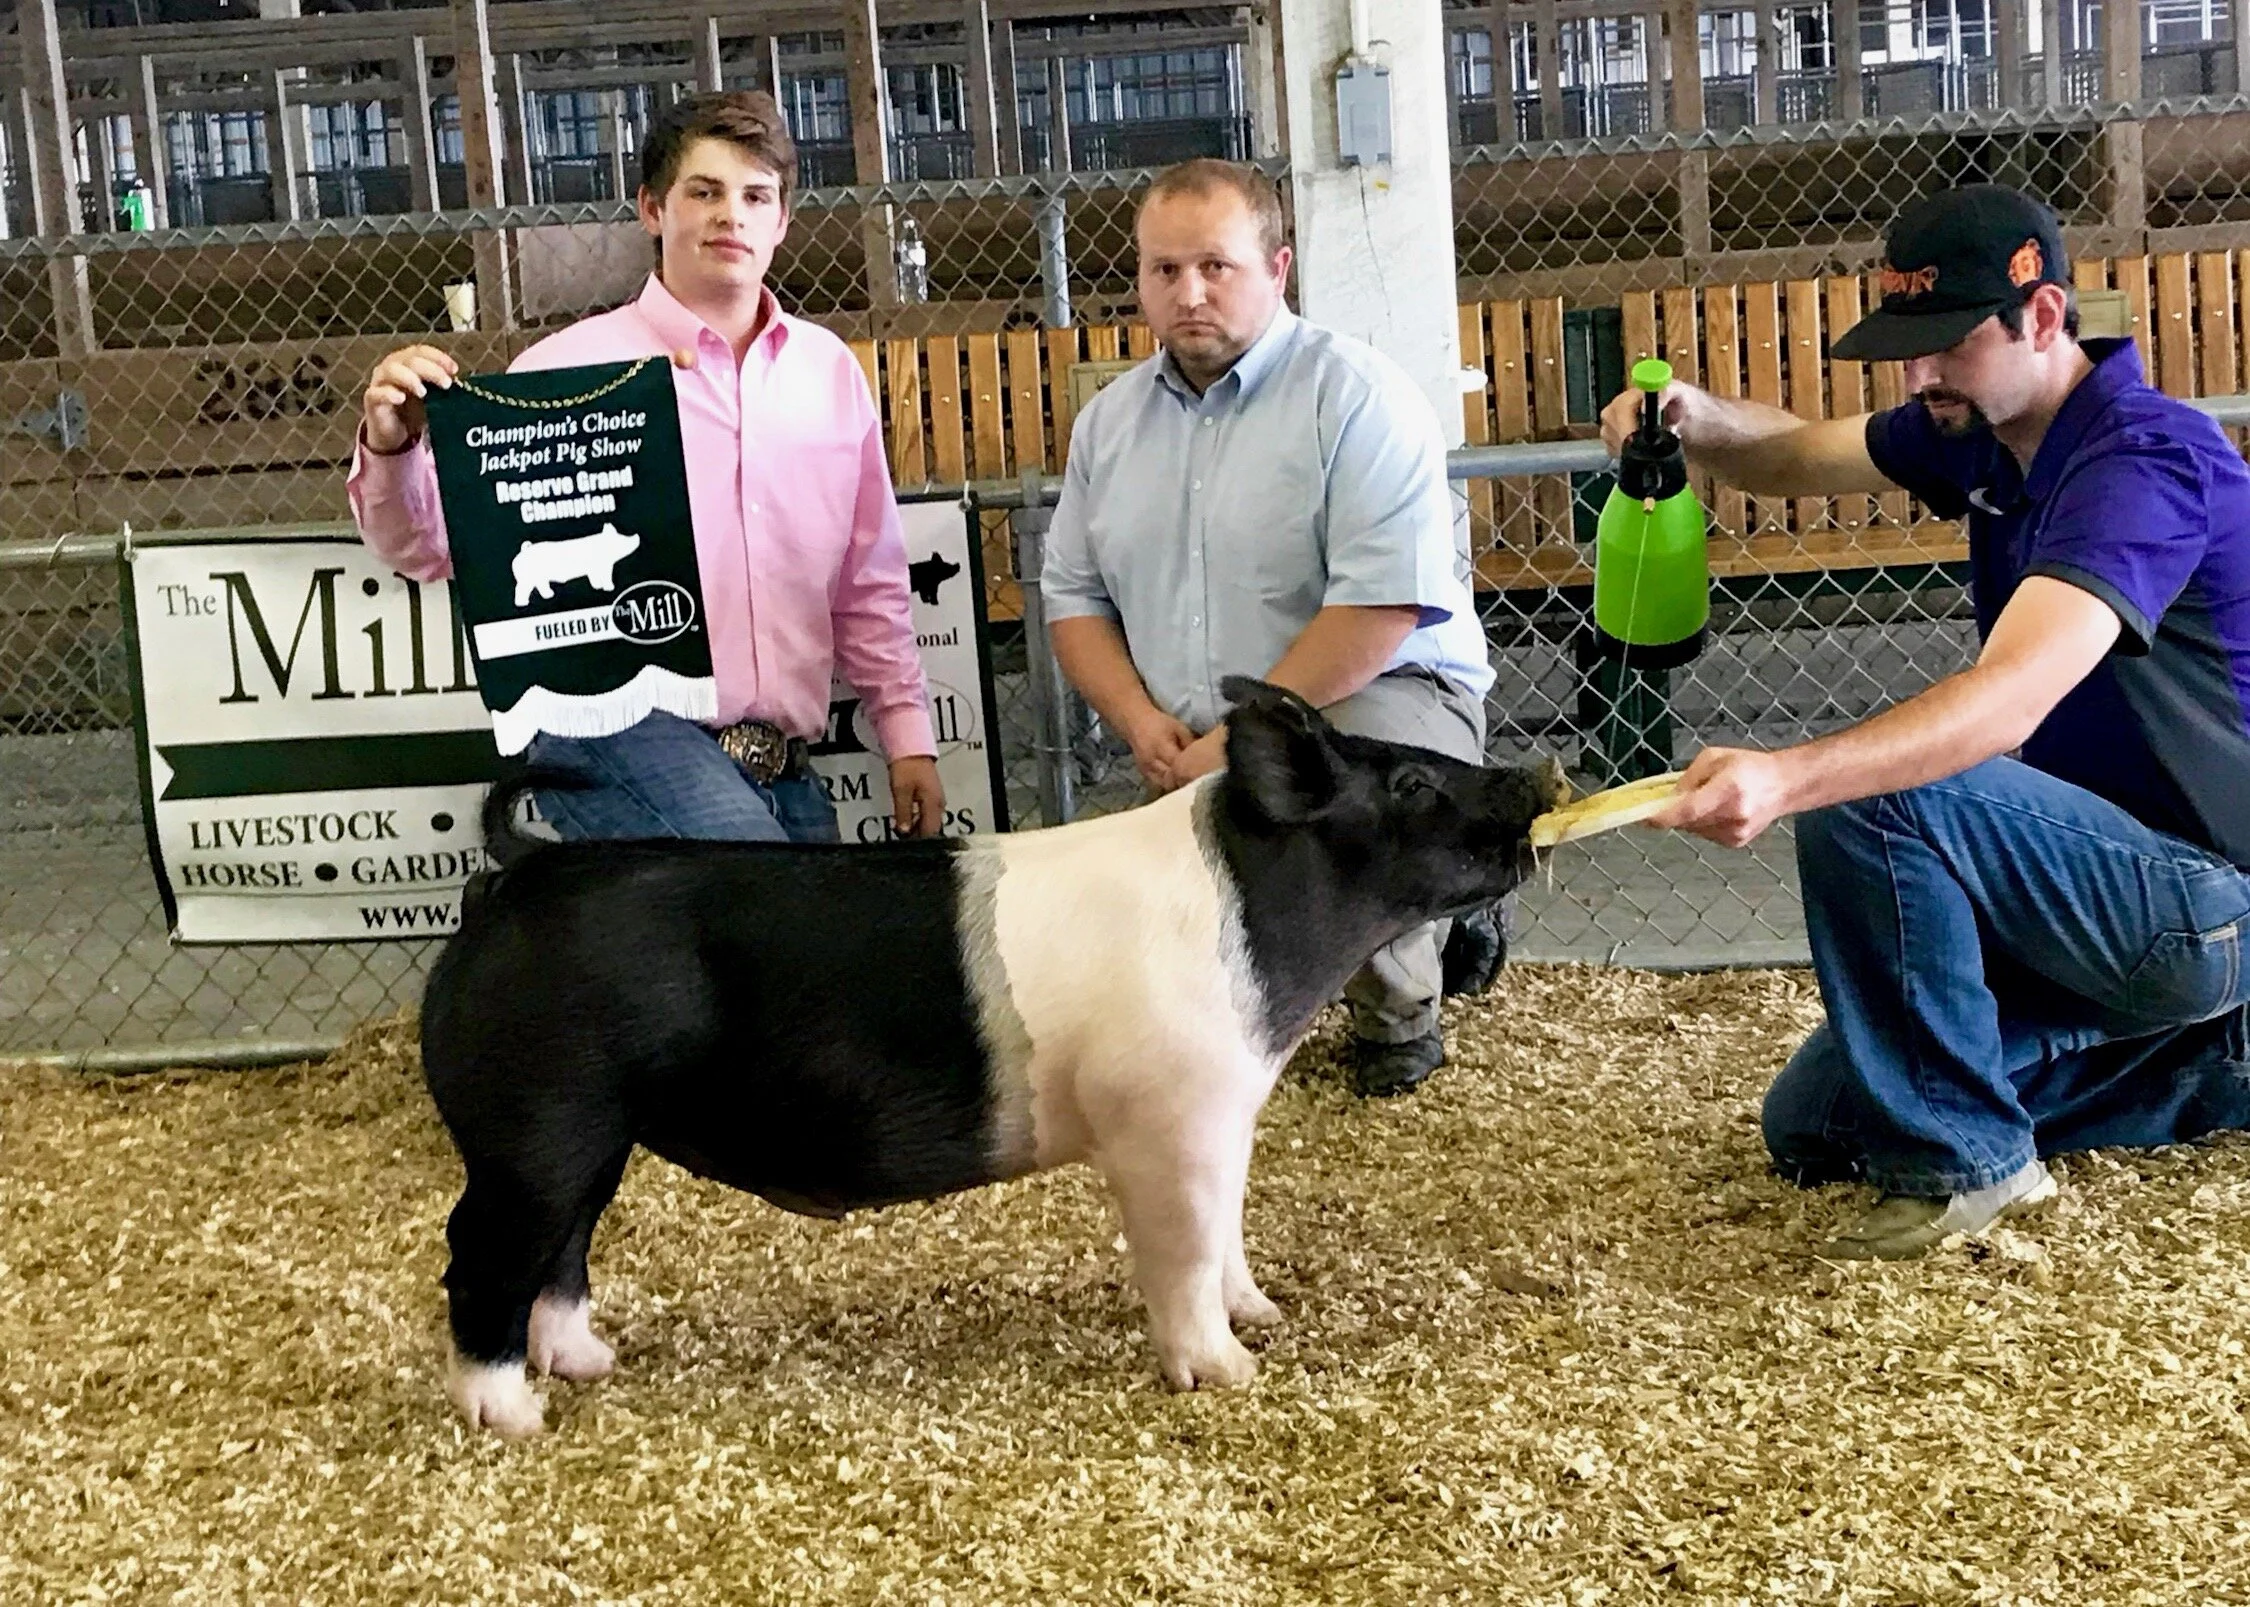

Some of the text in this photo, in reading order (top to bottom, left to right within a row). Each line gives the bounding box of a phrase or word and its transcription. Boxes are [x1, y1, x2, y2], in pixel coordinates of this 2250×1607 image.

[466, 410, 646, 447] Champion's Choice
[479, 437, 642, 476] Jackpot Pig Show
[495, 465, 634, 504] Reserve Grand
[520, 493, 616, 523] Champion
[535, 615, 609, 641] FUELED BY
[627, 592, 684, 634] Mill
[157, 567, 480, 704] The Mill
[188, 810, 401, 850] LIVESTOCK
[857, 808, 975, 844] CRPS
[180, 862, 304, 888] HORSE
